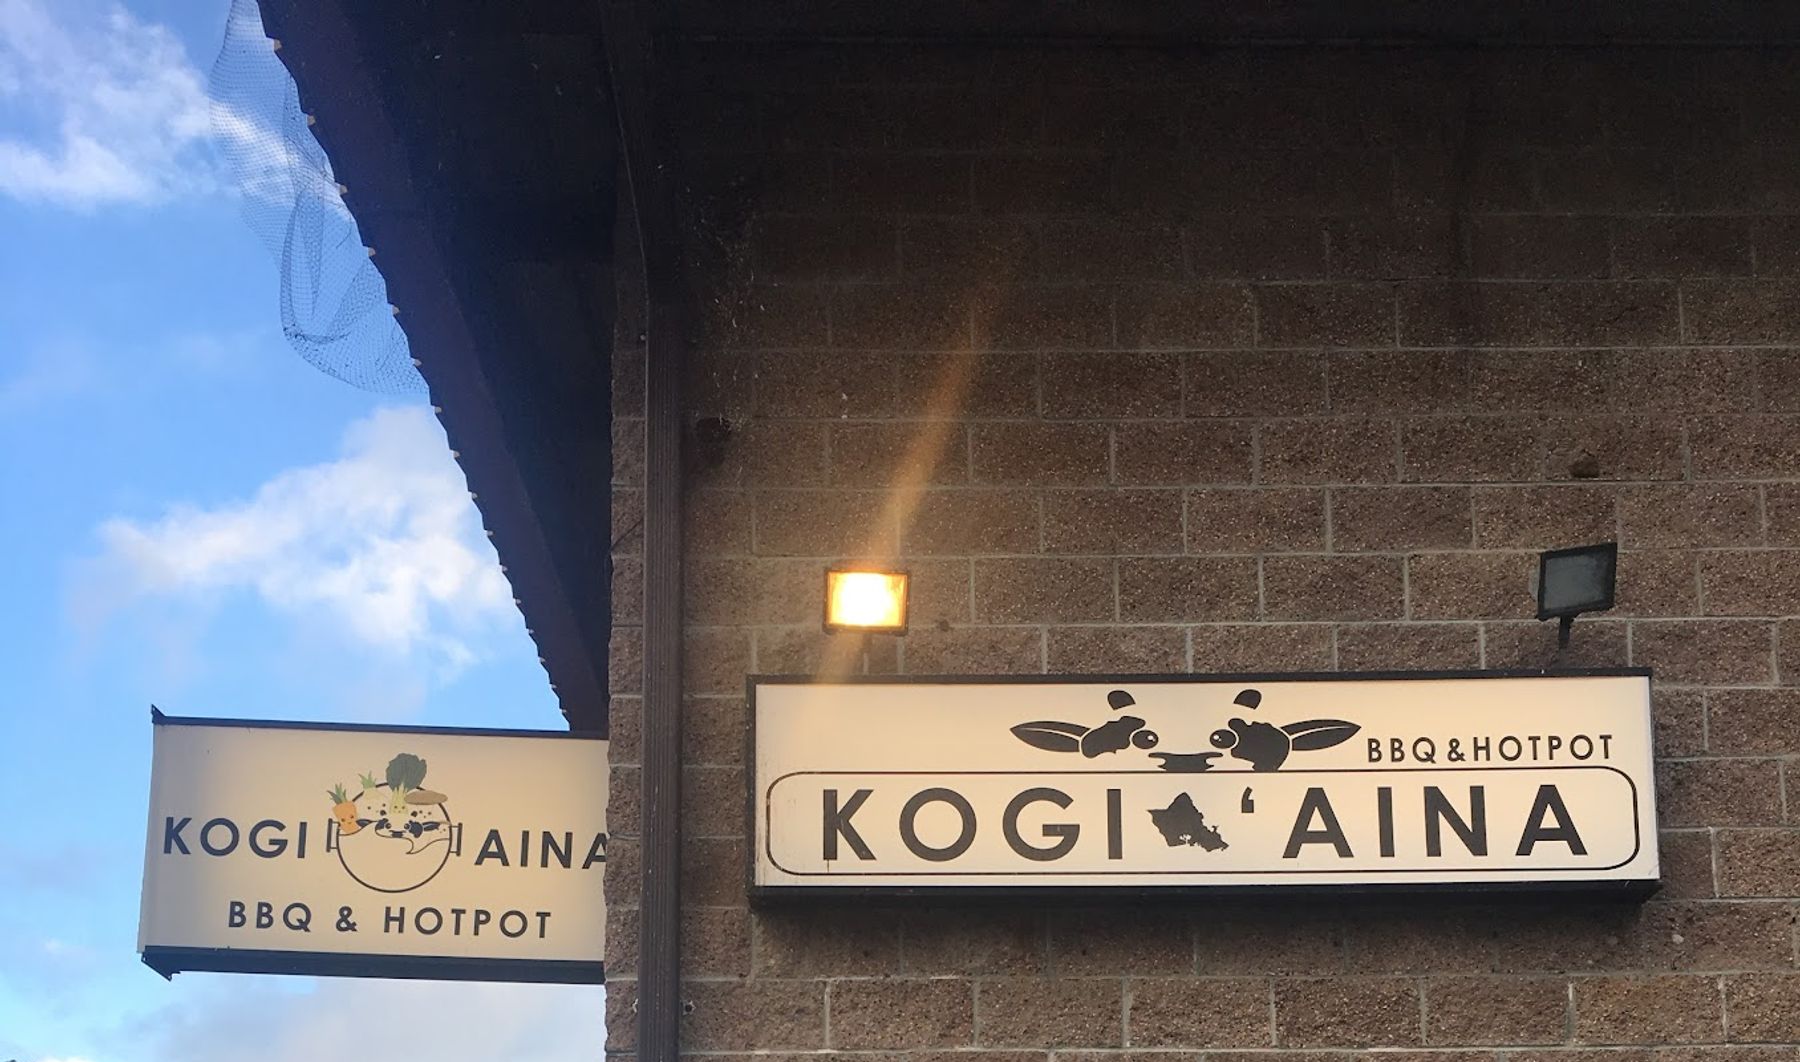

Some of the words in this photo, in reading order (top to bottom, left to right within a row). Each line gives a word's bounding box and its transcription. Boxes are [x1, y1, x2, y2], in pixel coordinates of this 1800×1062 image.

[163, 816, 308, 859] KOGI
[474, 829, 607, 870] AINA
[822, 787, 1123, 862] KOGI
[228, 901, 312, 933] BBQ
[335, 906, 358, 932] &
[383, 906, 551, 939] HOTPOT
